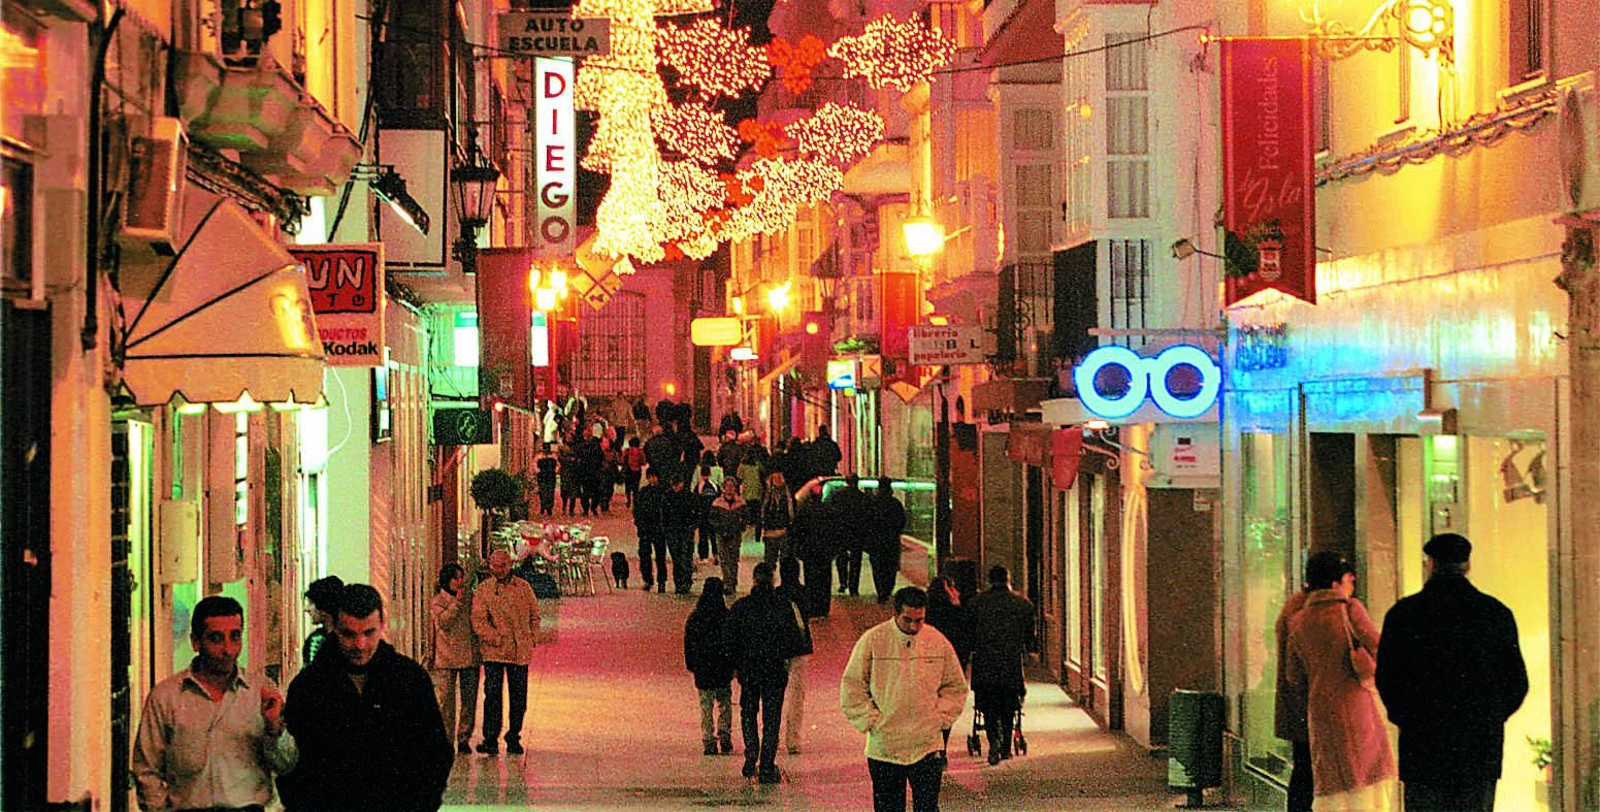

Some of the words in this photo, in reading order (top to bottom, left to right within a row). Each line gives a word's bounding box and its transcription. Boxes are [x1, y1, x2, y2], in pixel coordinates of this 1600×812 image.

[524, 17, 585, 33] AUTO
[508, 36, 599, 51] ESCUELA
[1257, 57, 1280, 170] Felicidades
[540, 71, 570, 244] DIEGO
[323, 341, 378, 356] Kodak
